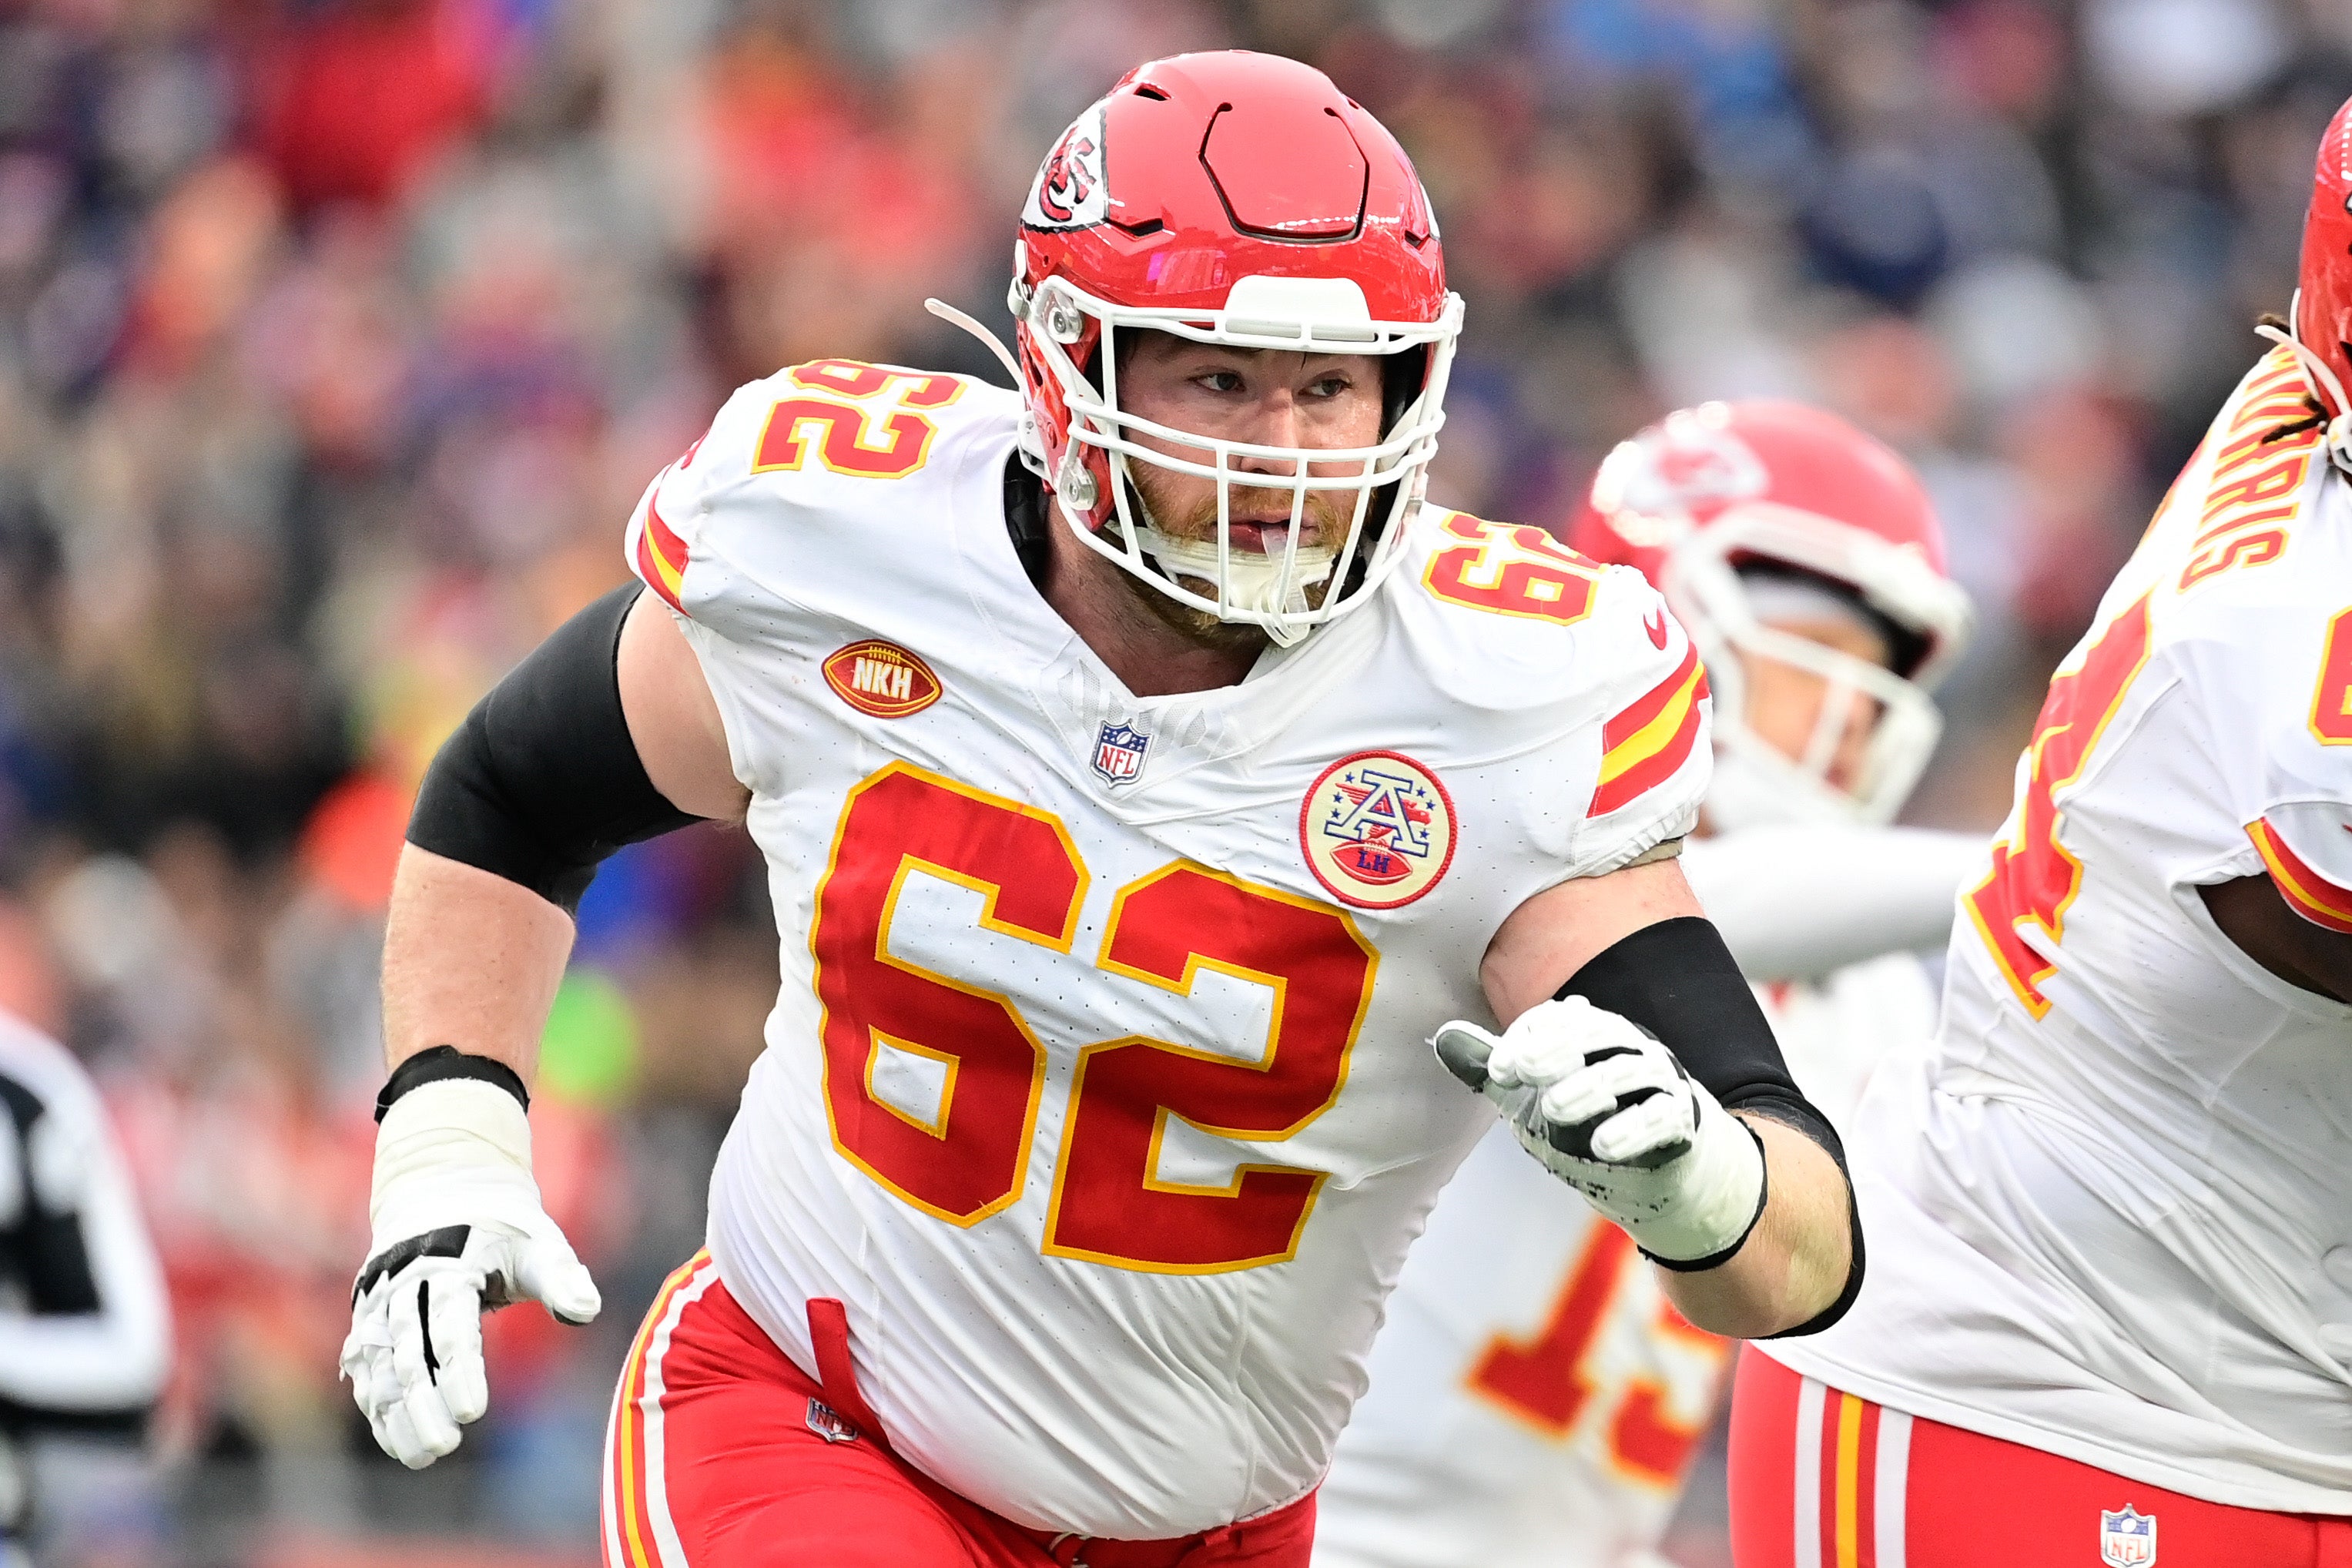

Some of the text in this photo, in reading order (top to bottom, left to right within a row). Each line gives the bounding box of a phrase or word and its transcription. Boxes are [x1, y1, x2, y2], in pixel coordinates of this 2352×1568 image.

[750, 357, 968, 479] 62
[1421, 510, 1608, 626] 62
[851, 656, 913, 701] NKH
[1098, 745, 1134, 776] NFL
[1323, 769, 1429, 858] A
[1356, 849, 1391, 873] LH
[808, 759, 1380, 1275] 62
[2111, 1536, 2146, 1562] NFL
